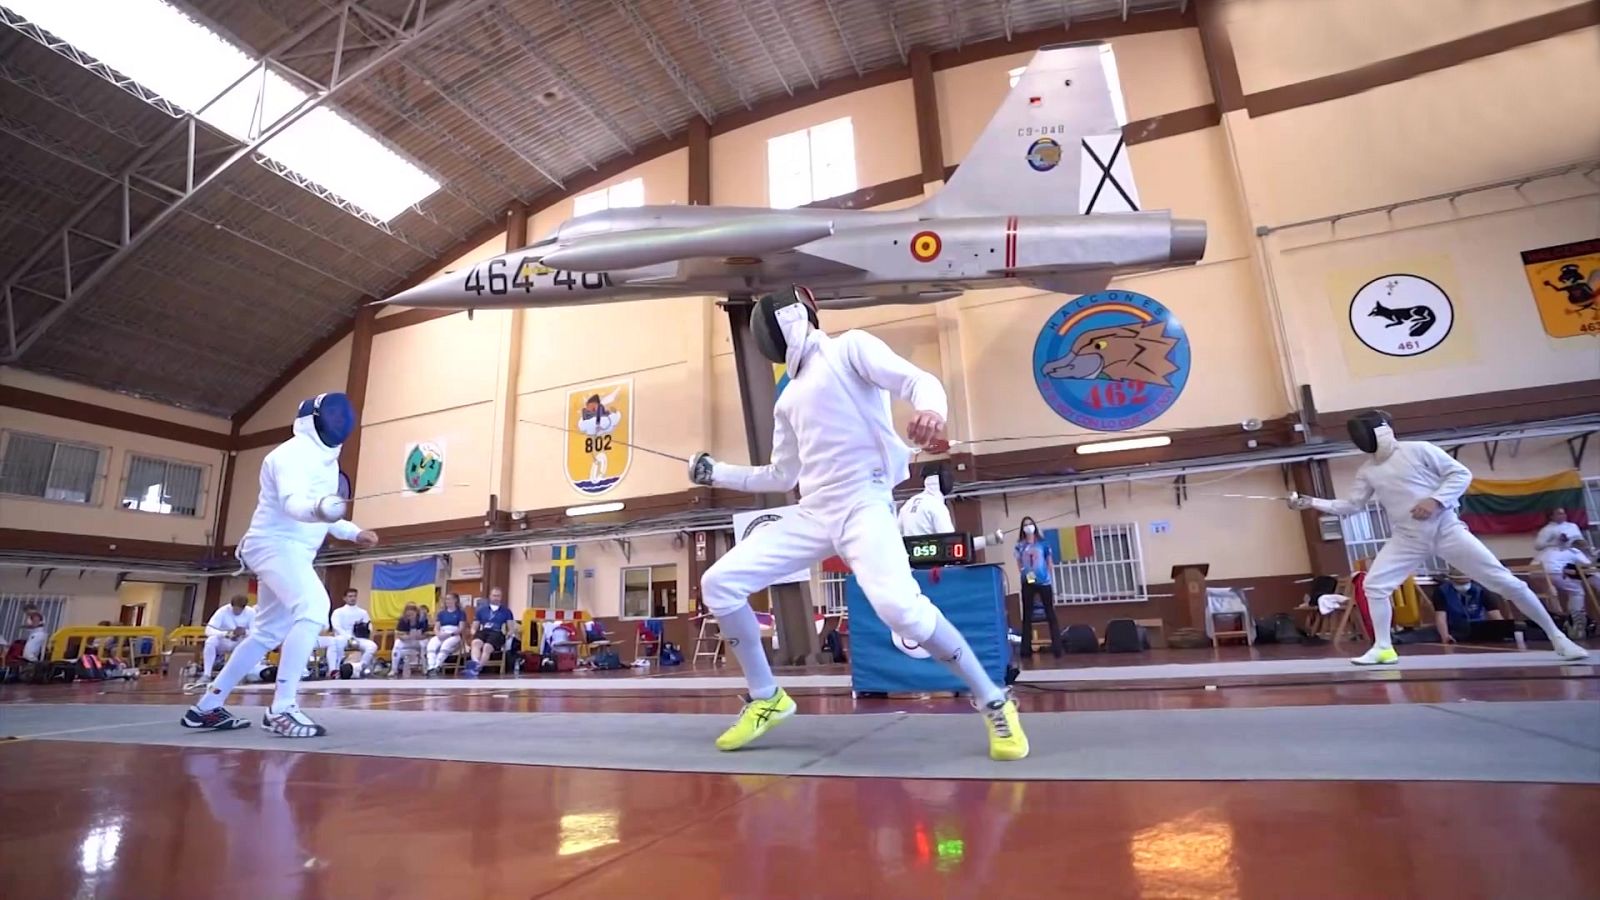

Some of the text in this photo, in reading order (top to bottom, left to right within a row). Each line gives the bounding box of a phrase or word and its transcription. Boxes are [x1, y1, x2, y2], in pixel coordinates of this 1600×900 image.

[1048, 292, 1165, 331] HALCONES
[1398, 341, 1420, 350] 461
[1083, 379, 1148, 409] 462
[585, 434, 612, 453] 802
[953, 544, 964, 557] 0
